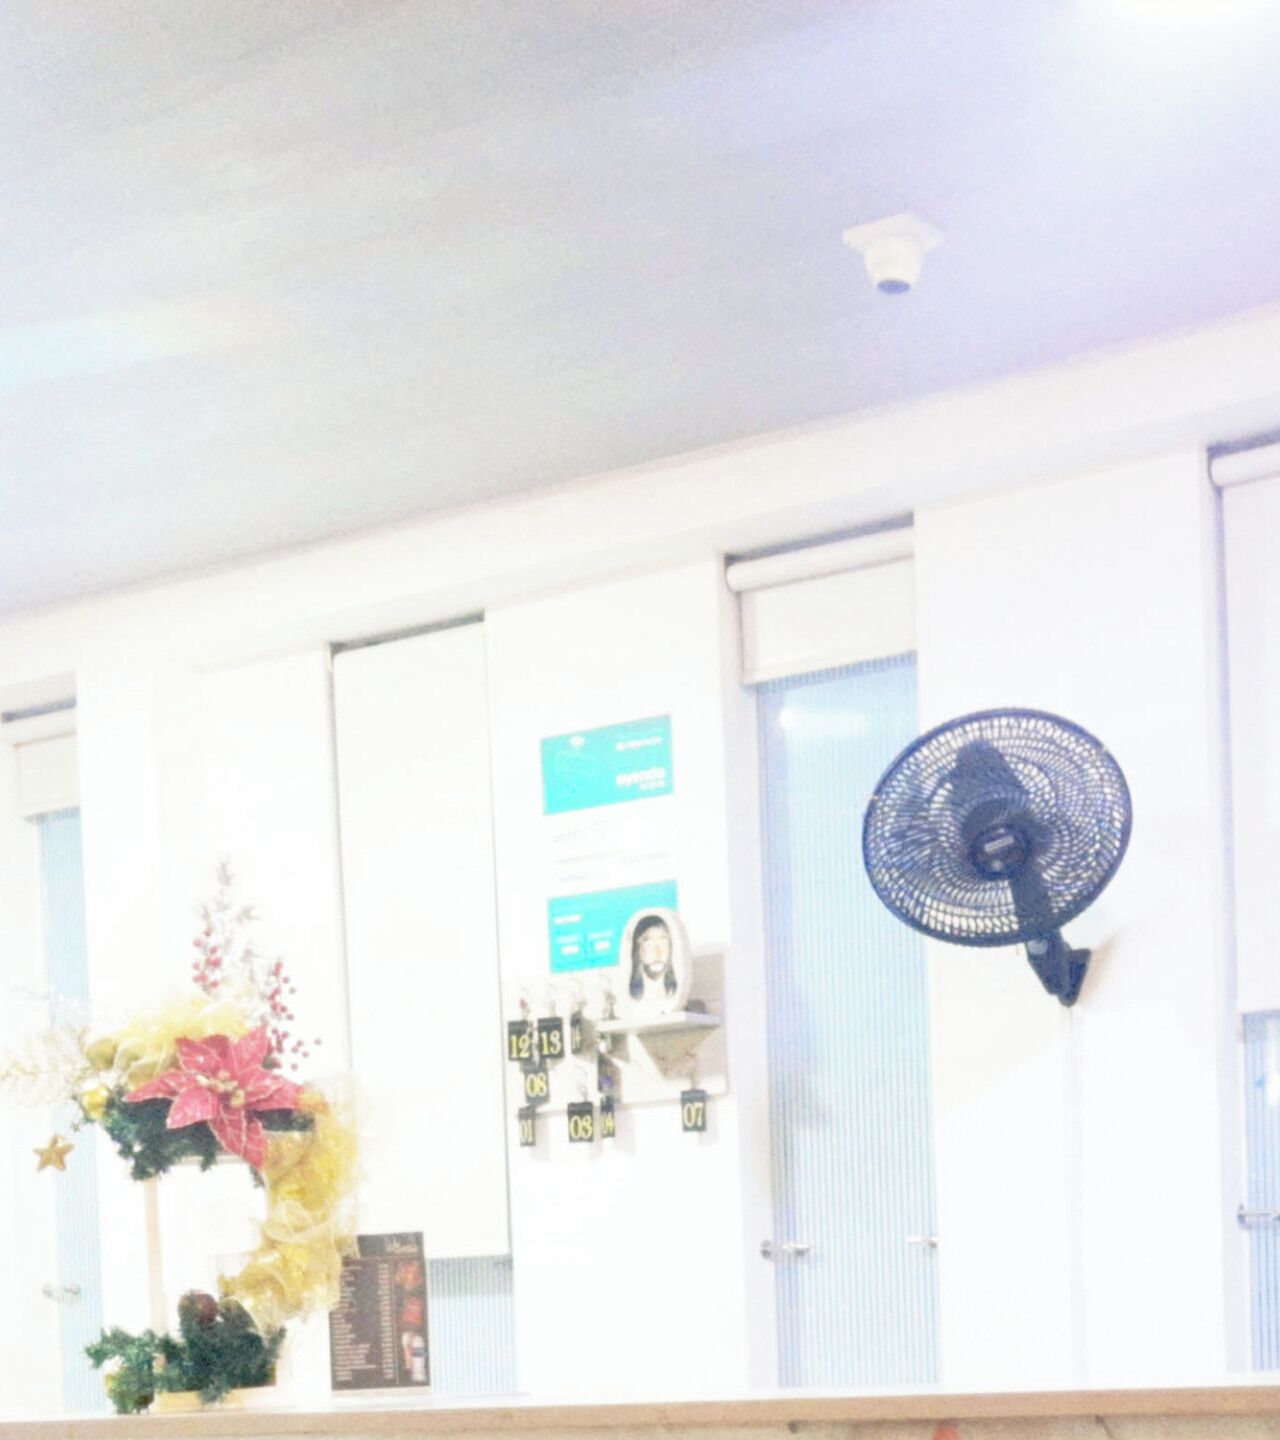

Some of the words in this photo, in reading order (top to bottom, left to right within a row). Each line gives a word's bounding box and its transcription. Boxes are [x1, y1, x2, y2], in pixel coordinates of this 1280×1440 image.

[511, 1035, 530, 1059] 12
[541, 1031, 562, 1056] 13
[526, 1072, 548, 1097] 08
[683, 1102, 704, 1127] 07
